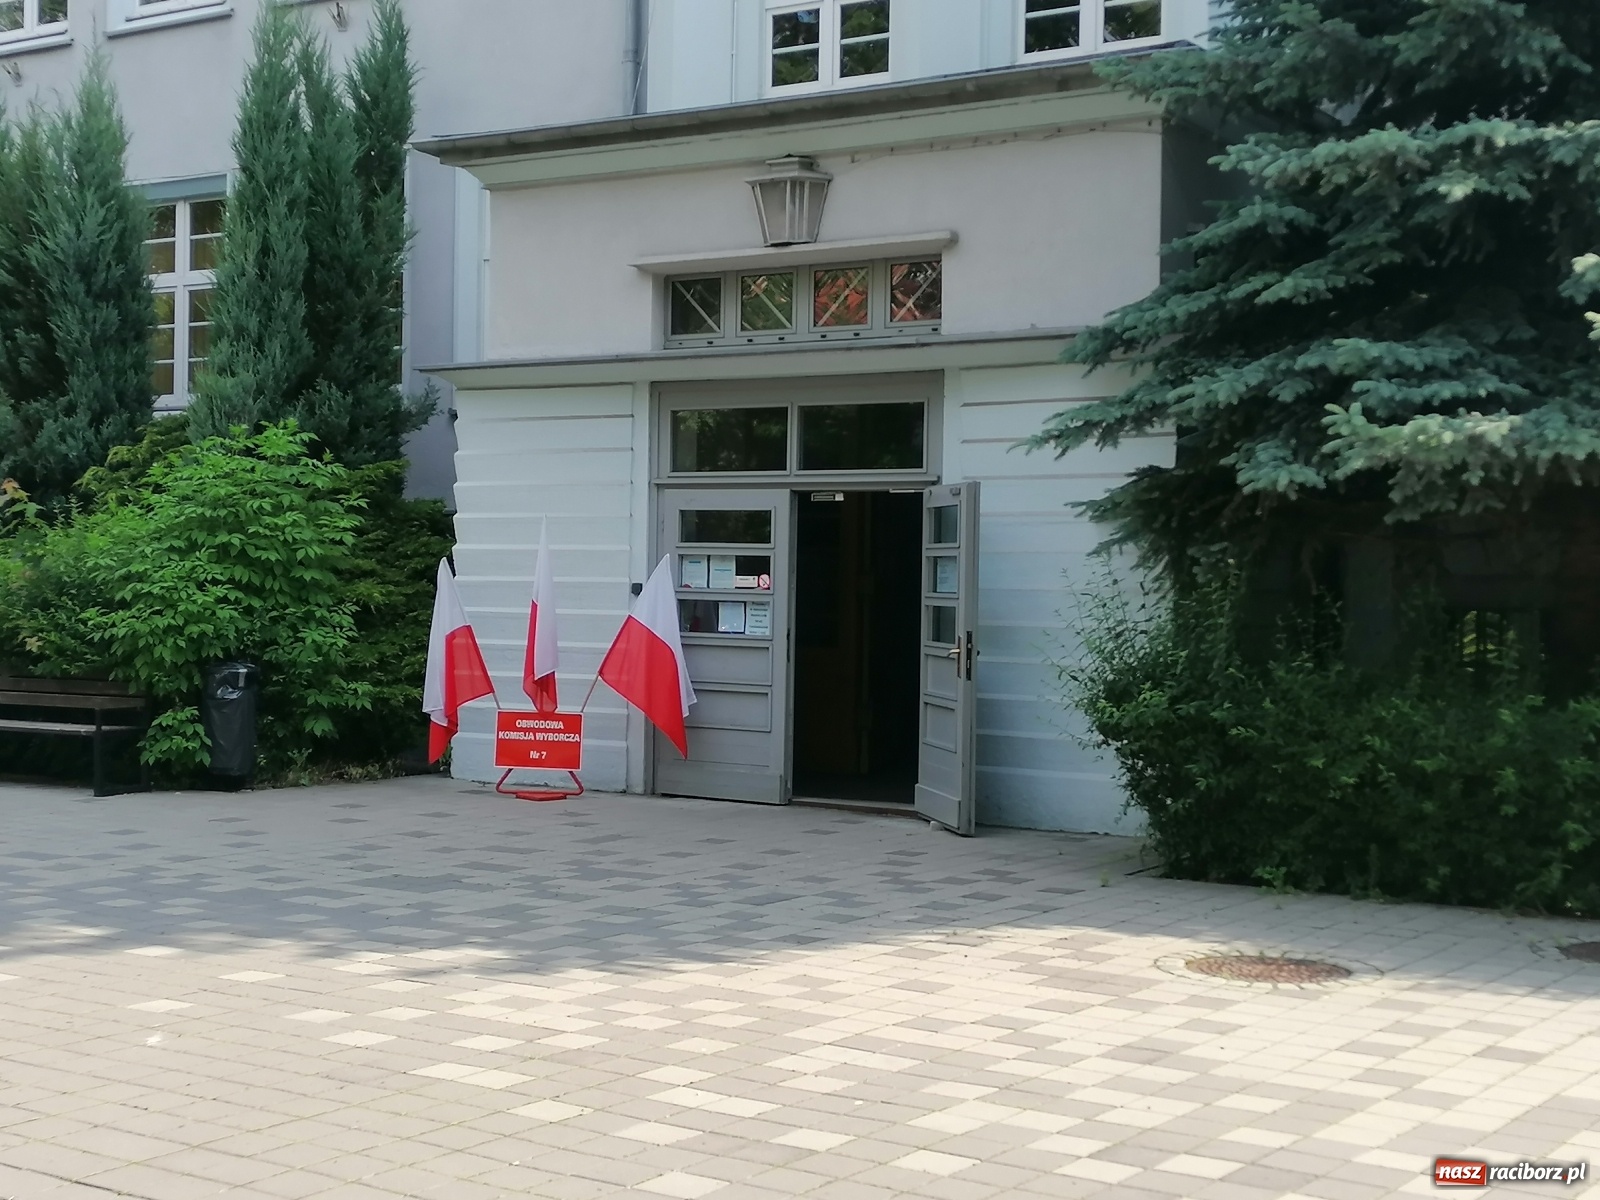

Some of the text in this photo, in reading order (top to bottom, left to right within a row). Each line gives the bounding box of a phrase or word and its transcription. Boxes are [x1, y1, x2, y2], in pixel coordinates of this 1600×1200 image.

[515, 719, 564, 729] OBWODOWA
[498, 731, 580, 742] KOMISJA WYBORCZA
[530, 750, 547, 759] Nr 7
